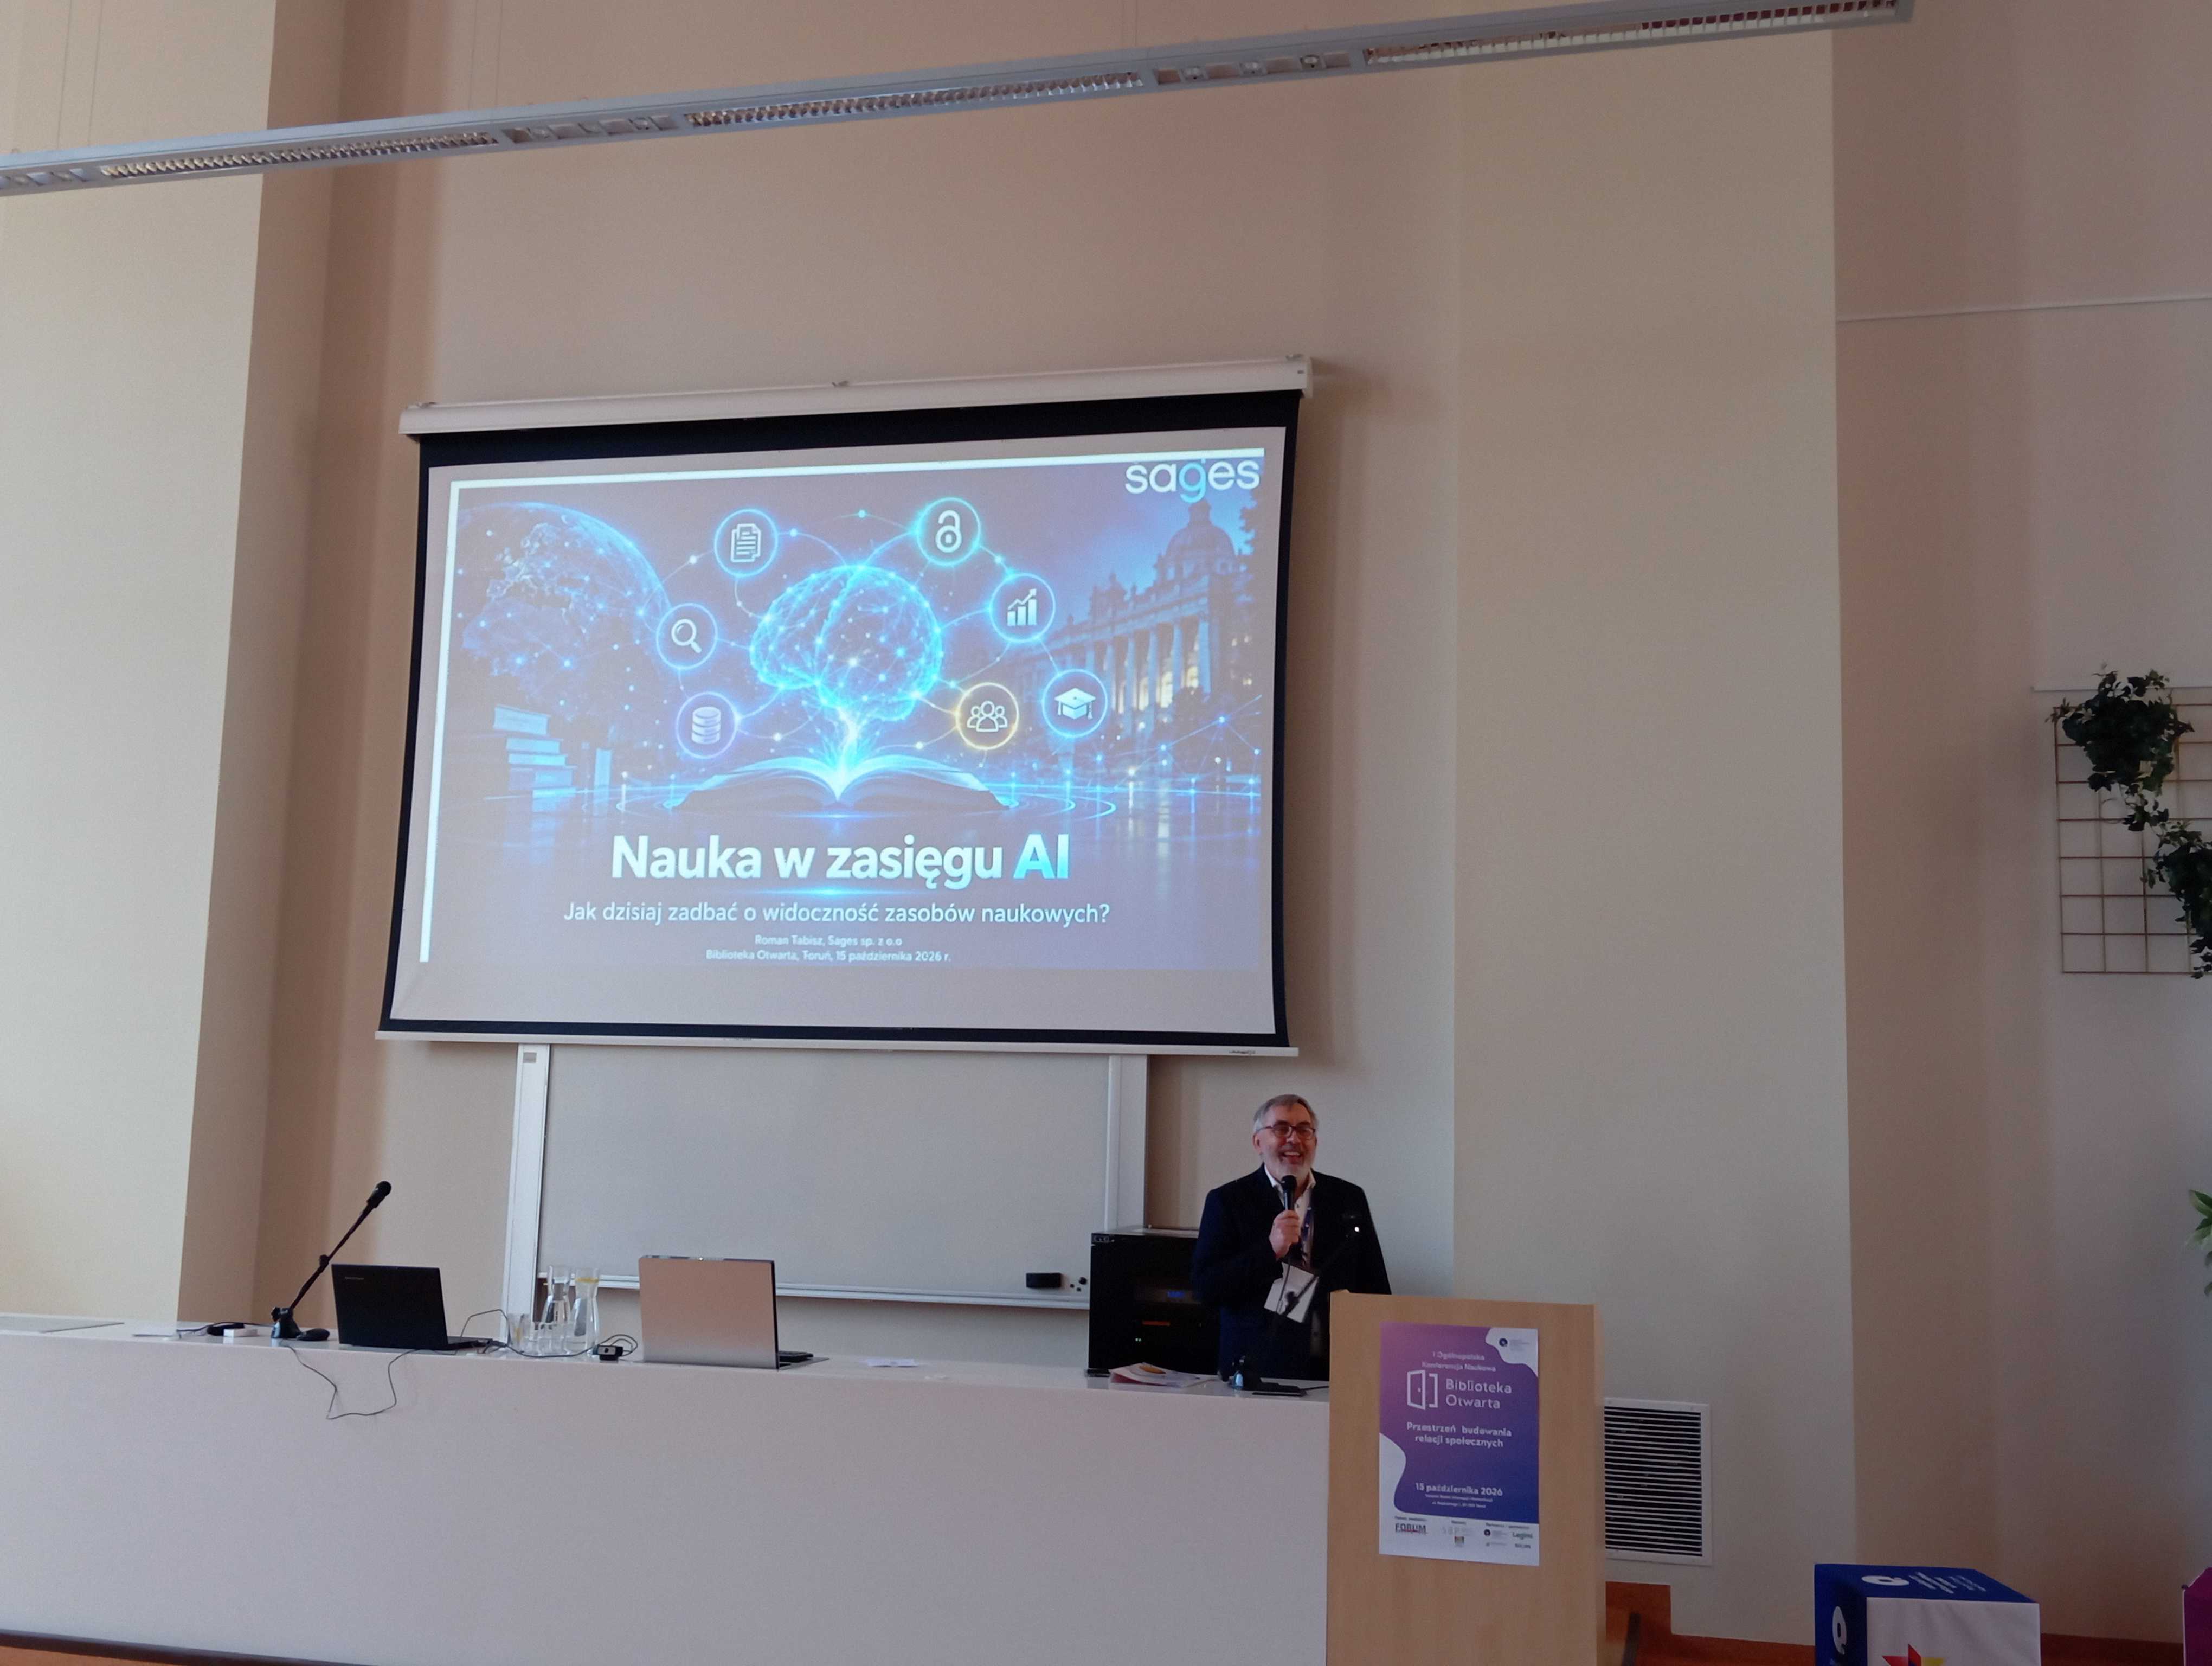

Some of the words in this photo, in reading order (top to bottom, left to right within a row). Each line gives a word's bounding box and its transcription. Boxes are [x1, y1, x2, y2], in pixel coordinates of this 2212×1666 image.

[1125, 459, 1260, 503] sages
[612, 835, 761, 879] Nauka
[774, 847, 815, 879] w
[826, 834, 1002, 889] zasięgu
[1013, 834, 1069, 879] AI
[564, 902, 596, 920] Jak
[602, 902, 662, 925] dzisiaj
[668, 902, 737, 921] zadbać
[743, 907, 756, 921] o
[763, 902, 879, 922] widoczność
[885, 902, 975, 922] zasobów
[982, 903, 1110, 928] naukowych?
[755, 934, 789, 945] Roman
[791, 935, 825, 946] Tabisz,
[828, 935, 858, 947] Sages
[860, 938, 874, 947] sp.
[878, 938, 883, 946] z
[706, 949, 755, 960] Biblioteka
[757, 950, 799, 961] Otwarta,
[835, 951, 846, 961] 15
[848, 951, 912, 962] października
[915, 951, 942, 962] 2026
[1446, 1378, 1512, 1394] Biblioteka
[1446, 1394, 1501, 1409] Otwarta
[1407, 1421, 1456, 1433] Przestrzeń
[1462, 1425, 1512, 1437] budowania
[1415, 1434, 1443, 1445] relacji
[1445, 1436, 1503, 1449] społecznych
[1416, 1482, 1424, 1491] 15
[1426, 1484, 1479, 1495] października
[1481, 1487, 1503, 1496] 2026
